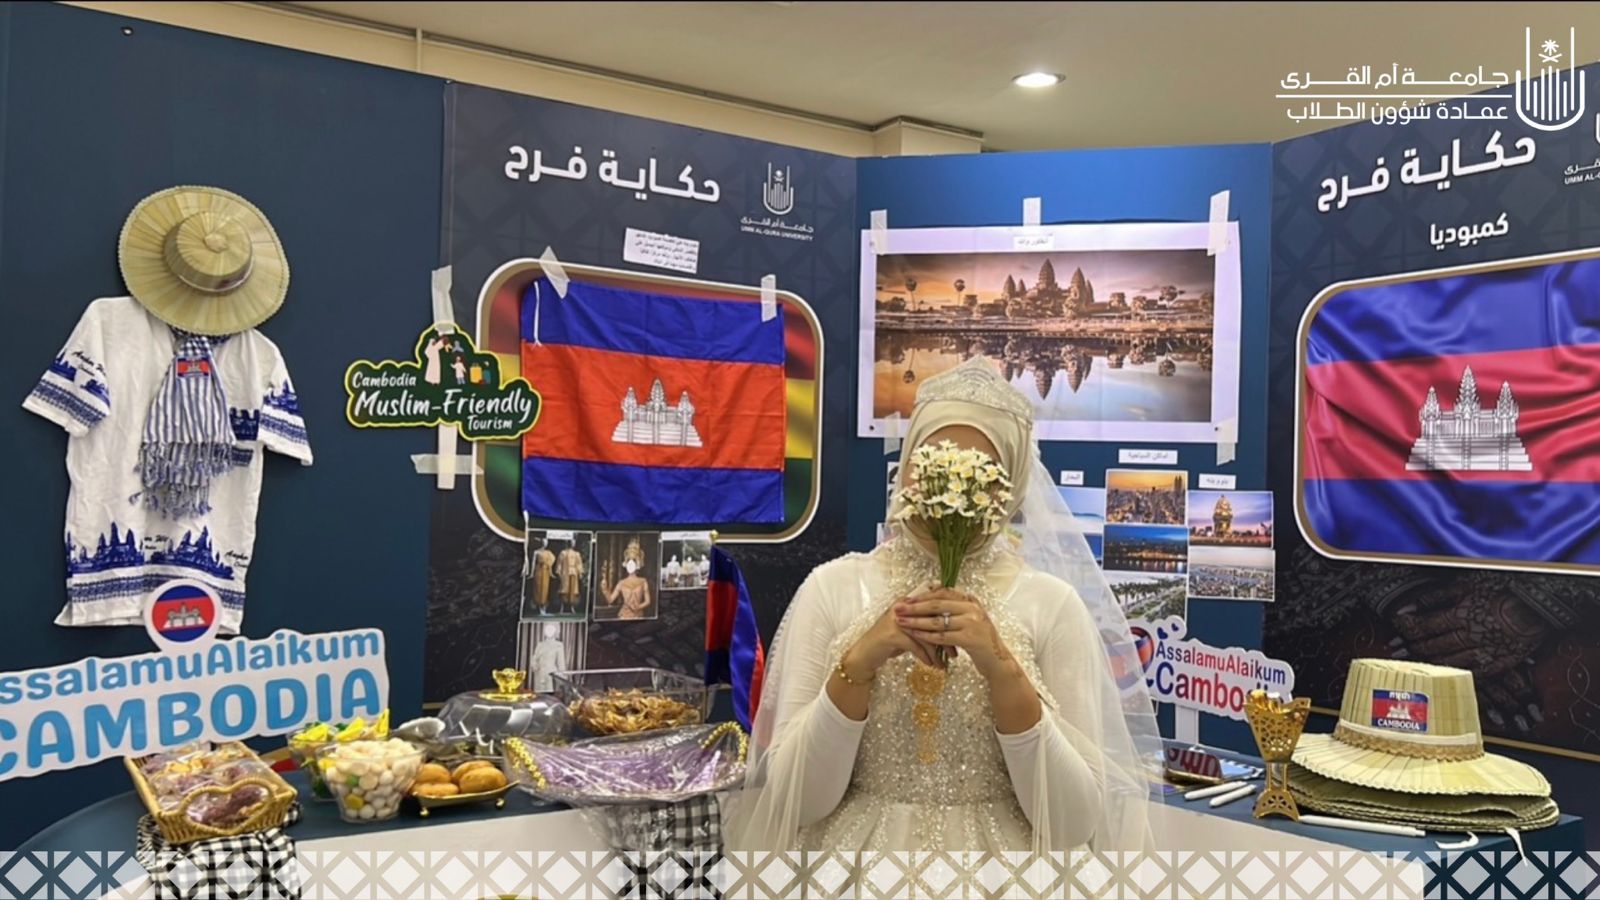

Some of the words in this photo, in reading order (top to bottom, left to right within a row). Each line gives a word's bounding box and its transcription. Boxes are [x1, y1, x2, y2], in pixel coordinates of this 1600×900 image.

[504, 145, 588, 182] فرح
[598, 149, 720, 203] حكاية
[1400, 129, 1537, 190] حكاية
[1317, 156, 1390, 212] فرح
[1429, 212, 1510, 250] كمبوديا
[352, 371, 417, 389] Cambodia
[353, 387, 533, 424] Muslim-Friendly
[467, 414, 514, 431] Tourism
[0, 631, 380, 705] ssalamuAlaikum
[1155, 640, 1286, 685] AssalamuAlaikum
[1155, 661, 1270, 713] Cambo
